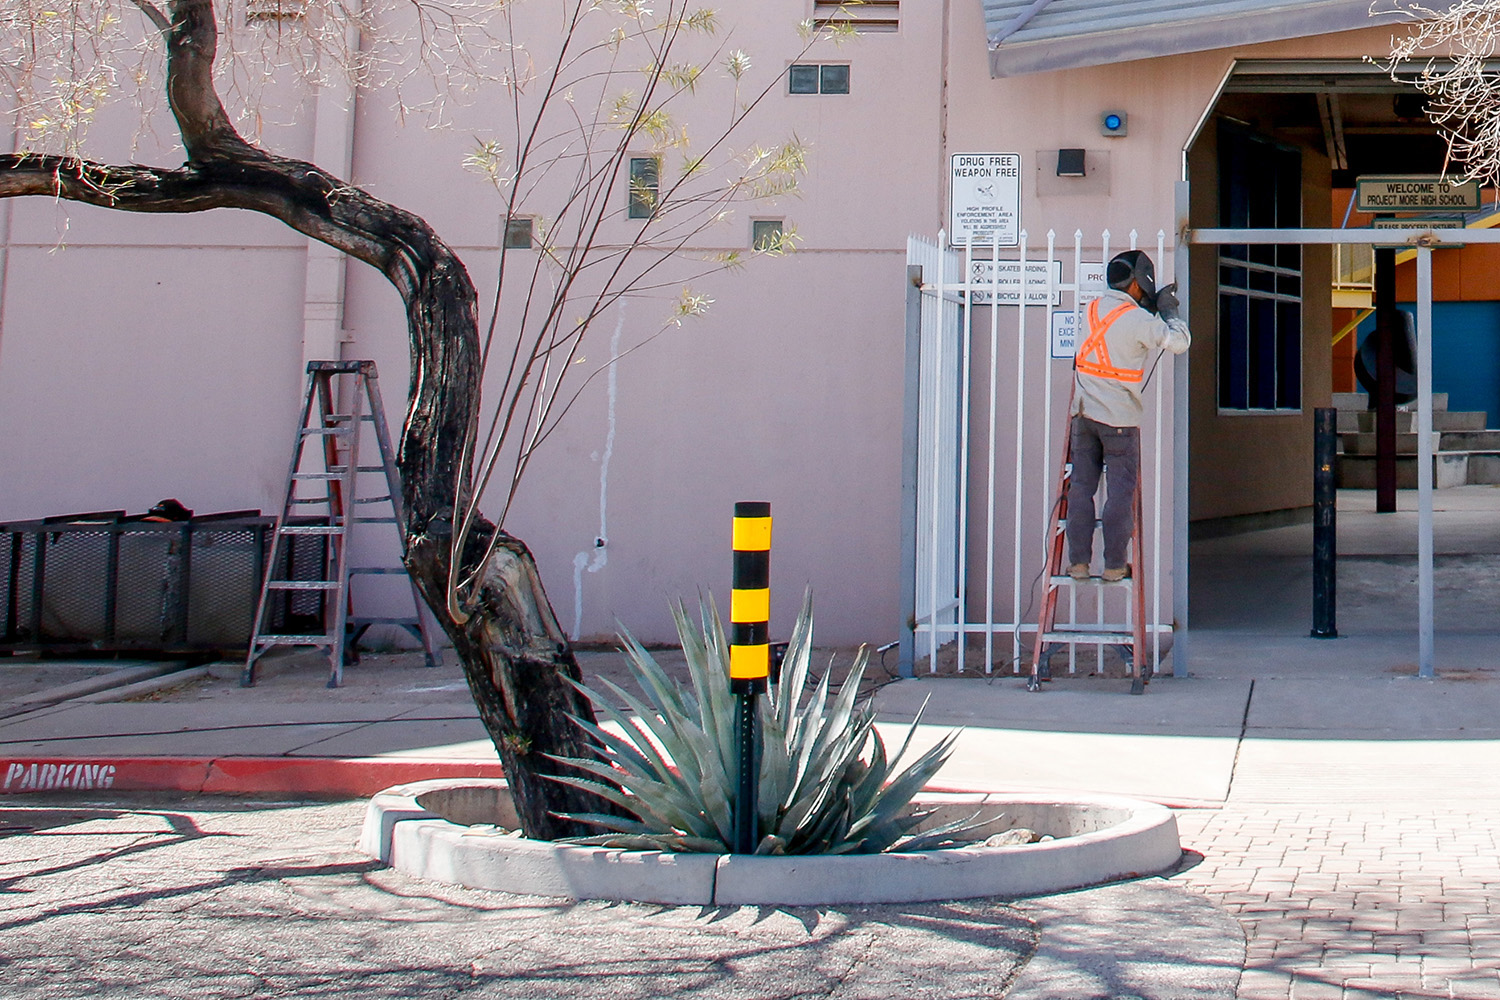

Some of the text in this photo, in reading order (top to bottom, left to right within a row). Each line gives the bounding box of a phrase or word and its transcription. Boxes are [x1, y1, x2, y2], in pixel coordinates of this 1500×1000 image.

[960, 157, 1012, 166] DRUG FREE
[954, 168, 1017, 177] WEAPON FREE
[1387, 183, 1450, 193] WELCOME TO
[1367, 195, 1466, 205] PROJECT MORE HIGH SCHOOL
[998, 265, 1047, 273] SKATEBARDING,
[3, 763, 117, 789] PARKING
